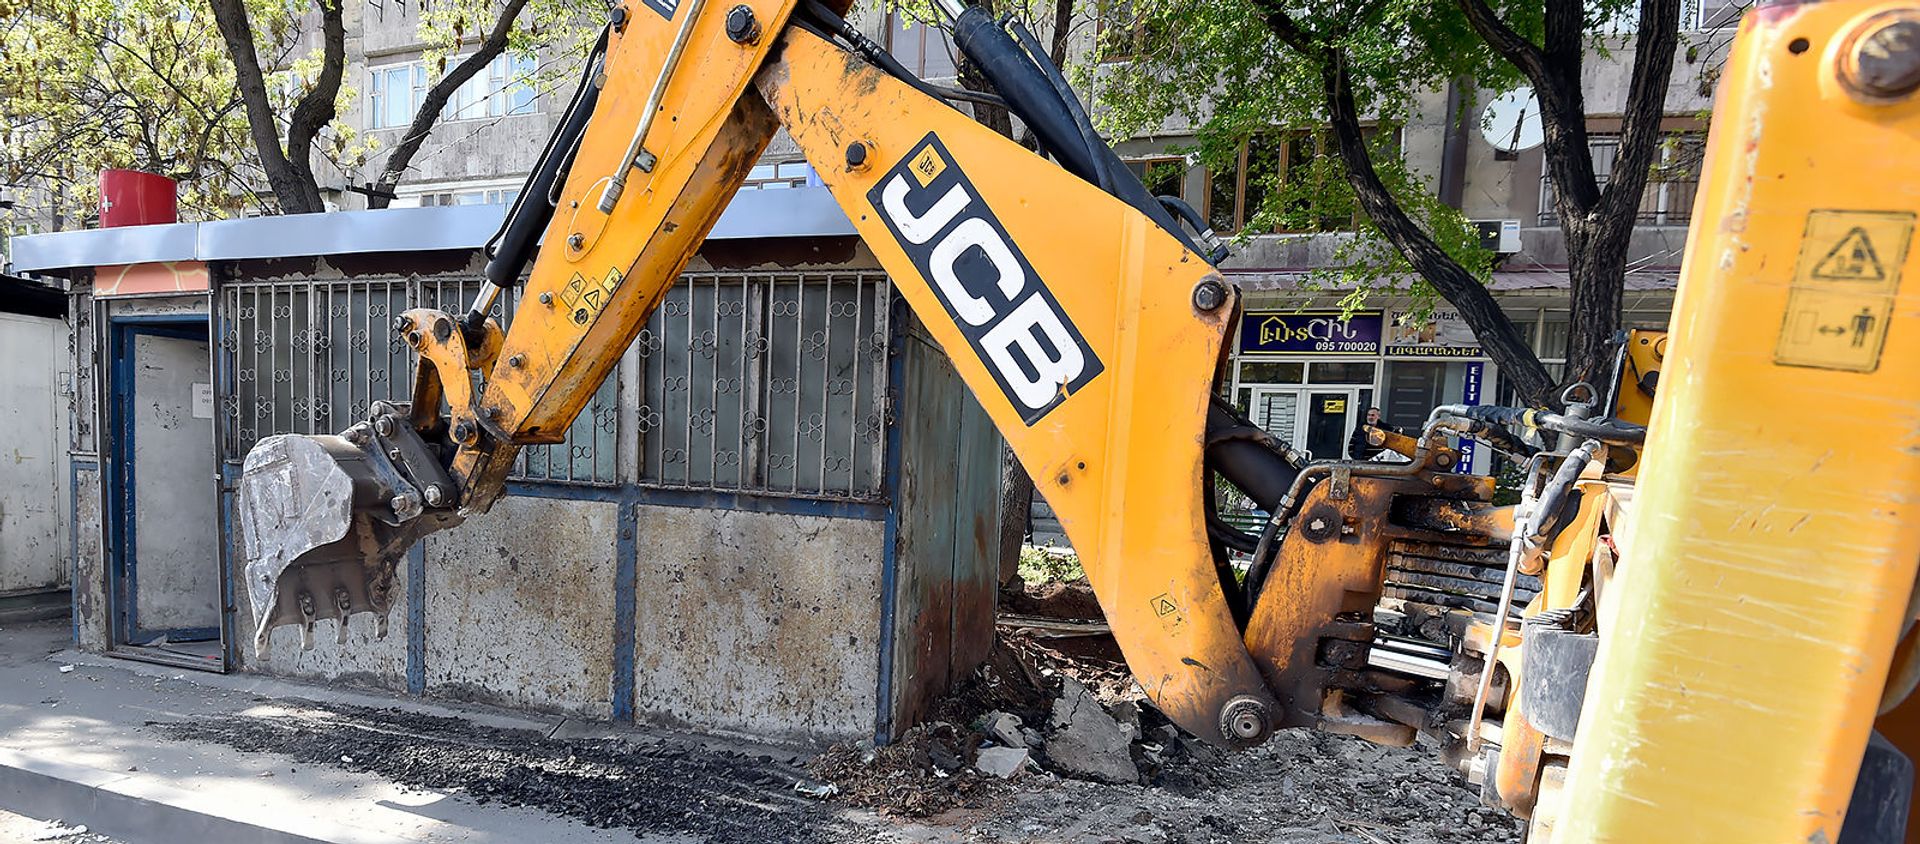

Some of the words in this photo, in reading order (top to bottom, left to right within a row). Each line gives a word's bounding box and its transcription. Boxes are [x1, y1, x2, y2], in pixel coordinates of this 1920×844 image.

[882, 172, 1085, 410] JCB
[1315, 341, 1335, 351] 095
[1338, 341, 1377, 351] 700020
[1467, 366, 1480, 401] ELIT
[1459, 445, 1472, 475] SHI
